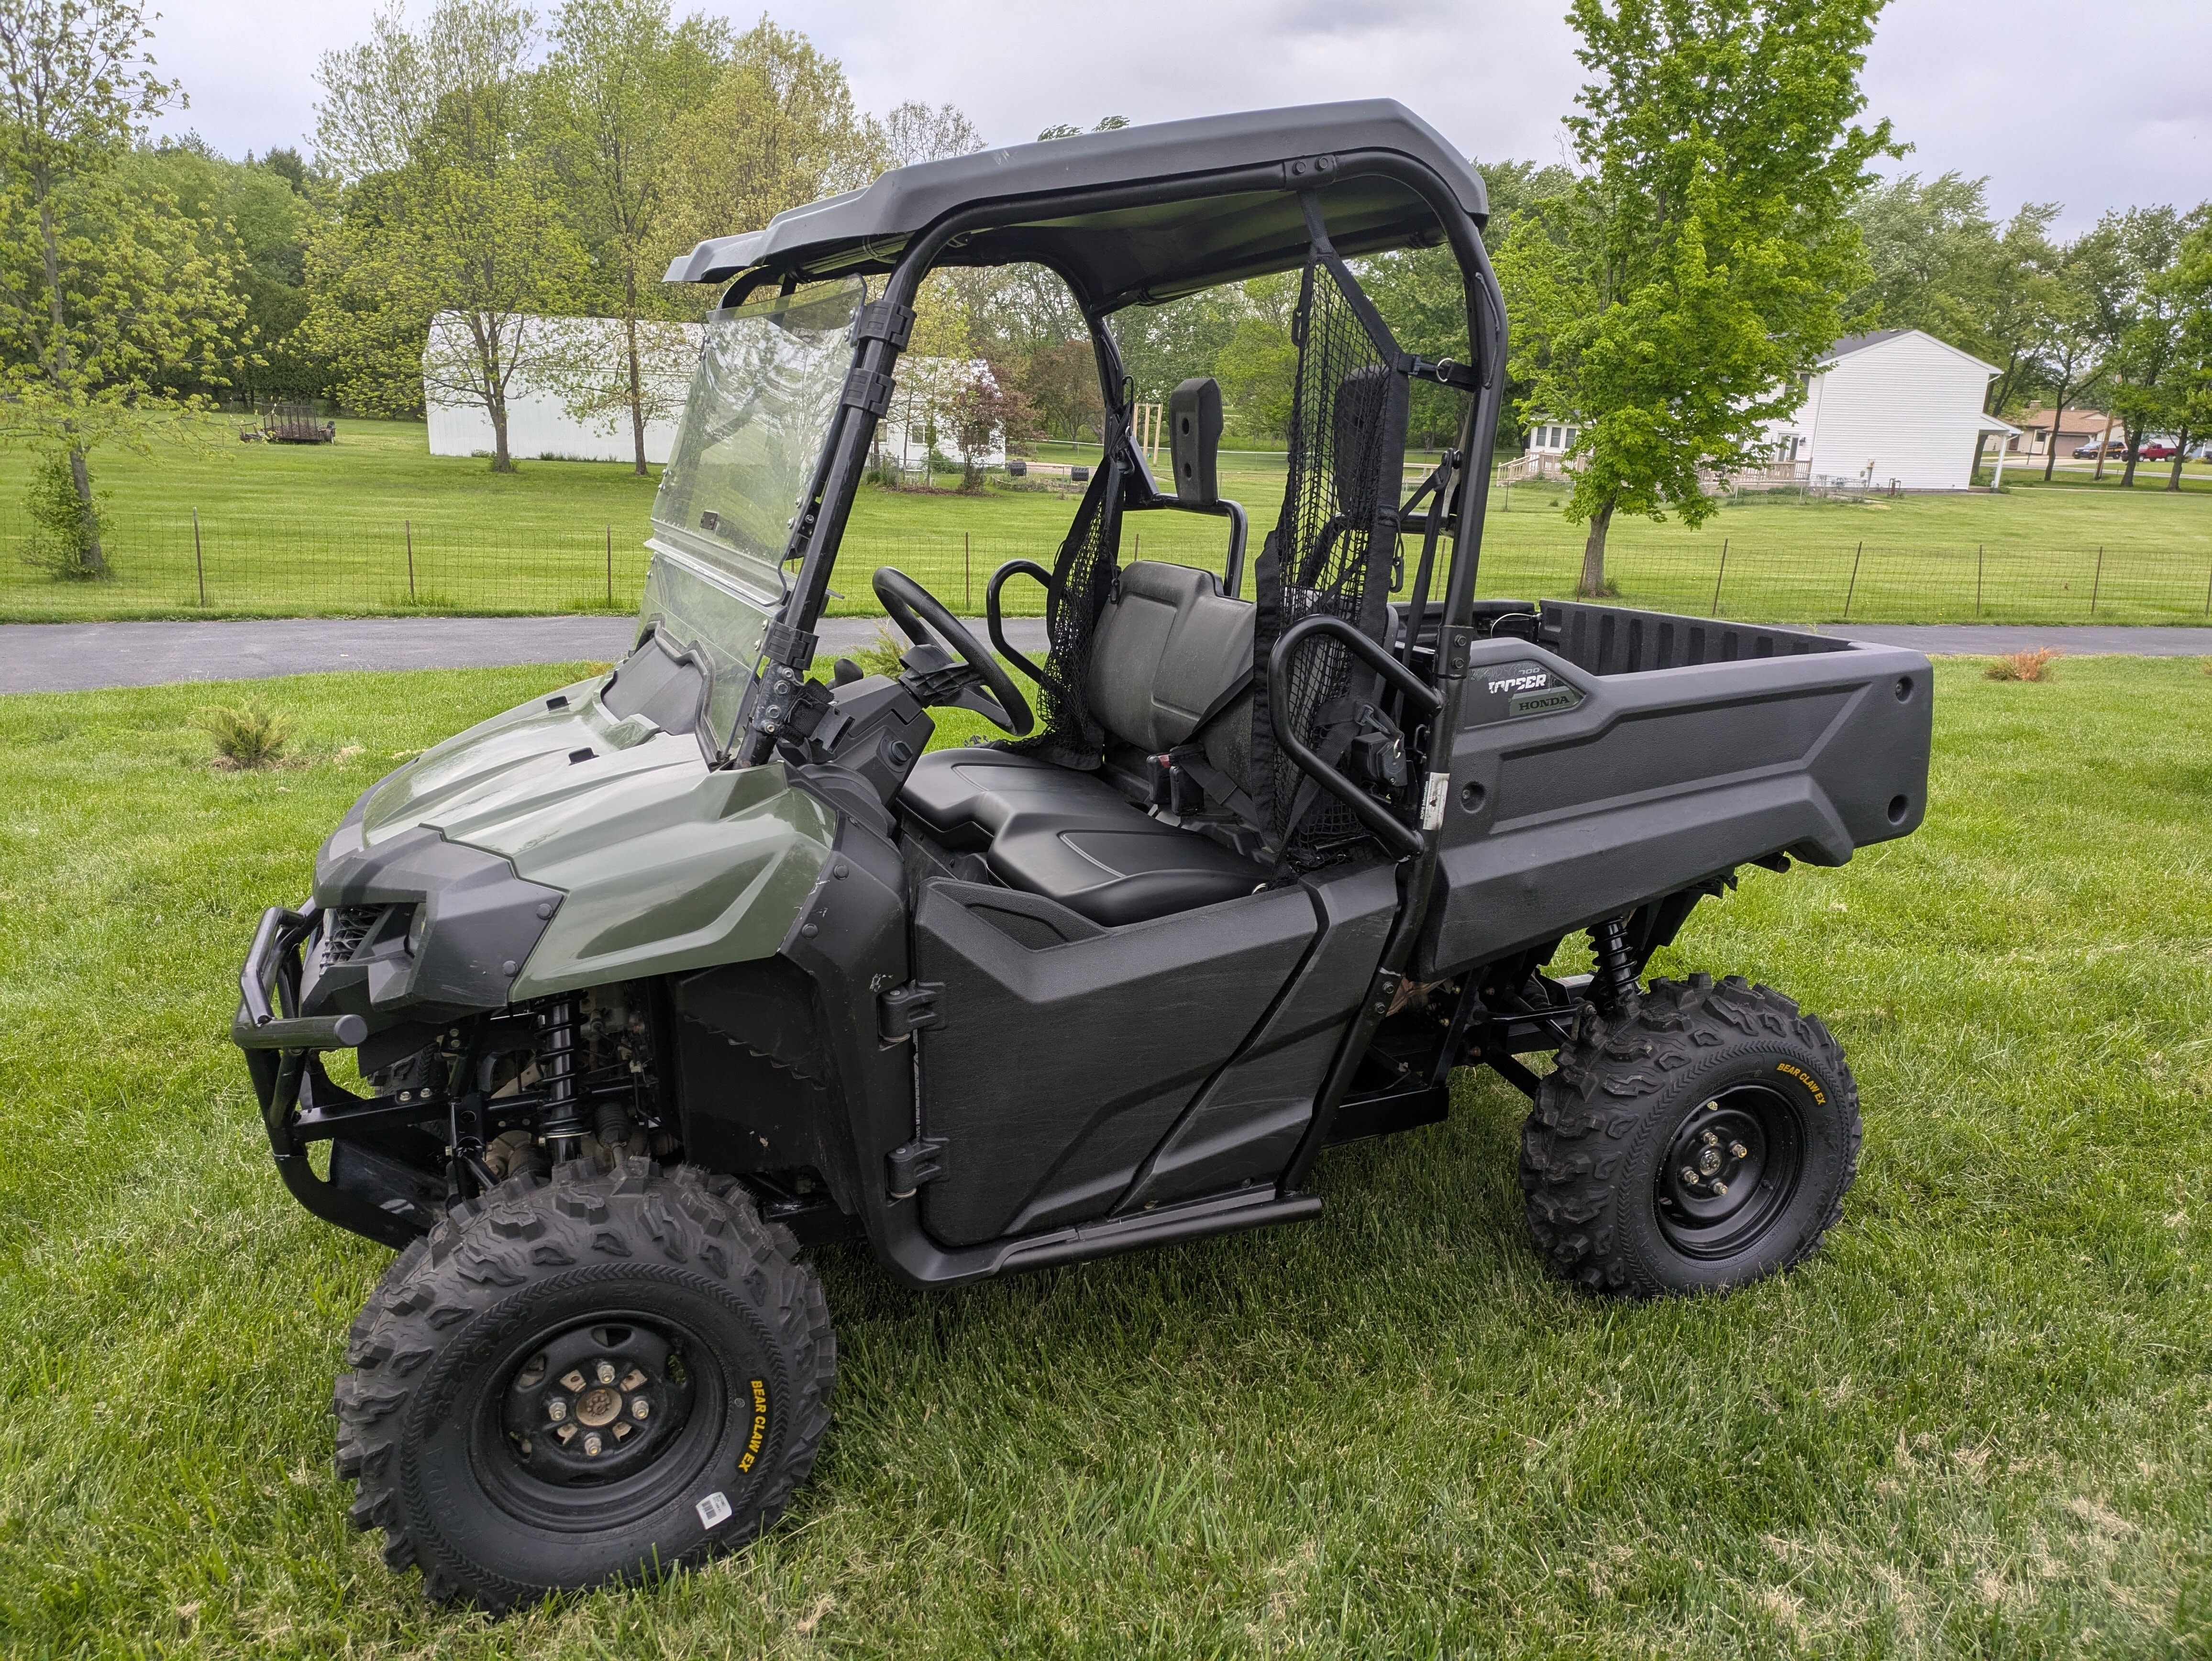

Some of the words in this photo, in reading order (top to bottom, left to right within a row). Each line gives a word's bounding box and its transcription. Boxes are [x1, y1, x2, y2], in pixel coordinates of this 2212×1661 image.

[1519, 696, 1570, 711] HONDA
[1776, 1063, 1801, 1076] BEAR
[1799, 1073, 1820, 1093] CLAW
[1814, 1092, 1825, 1106] EX
[1635, 1223, 1666, 1273] BEAR
[434, 1339, 496, 1419] BEAR
[751, 1380, 766, 1412] BEAR
[748, 1416, 766, 1453] CLAW
[738, 1452, 755, 1473] EX
